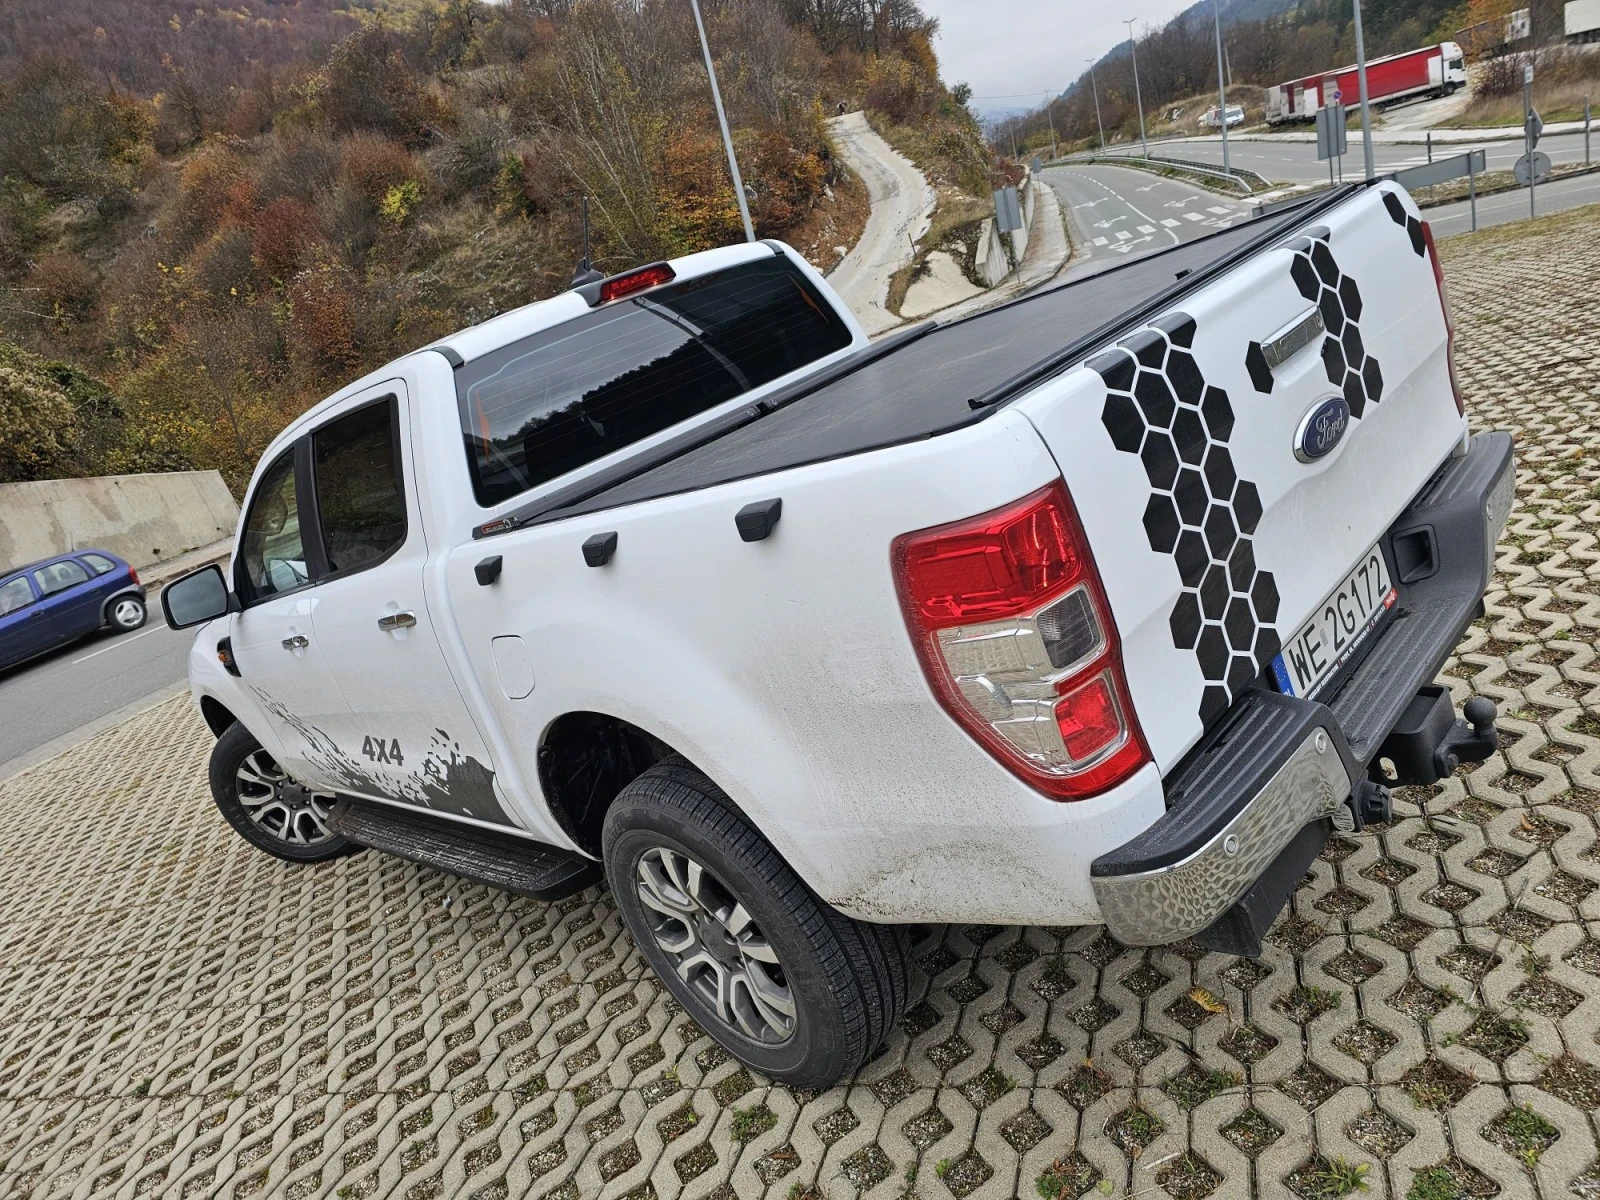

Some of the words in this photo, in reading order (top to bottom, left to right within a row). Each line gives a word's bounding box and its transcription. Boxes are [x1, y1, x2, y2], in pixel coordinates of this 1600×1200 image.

[1315, 407, 1346, 450] Ford
[1288, 622, 1327, 691] WE
[1324, 554, 1387, 653] 2G172
